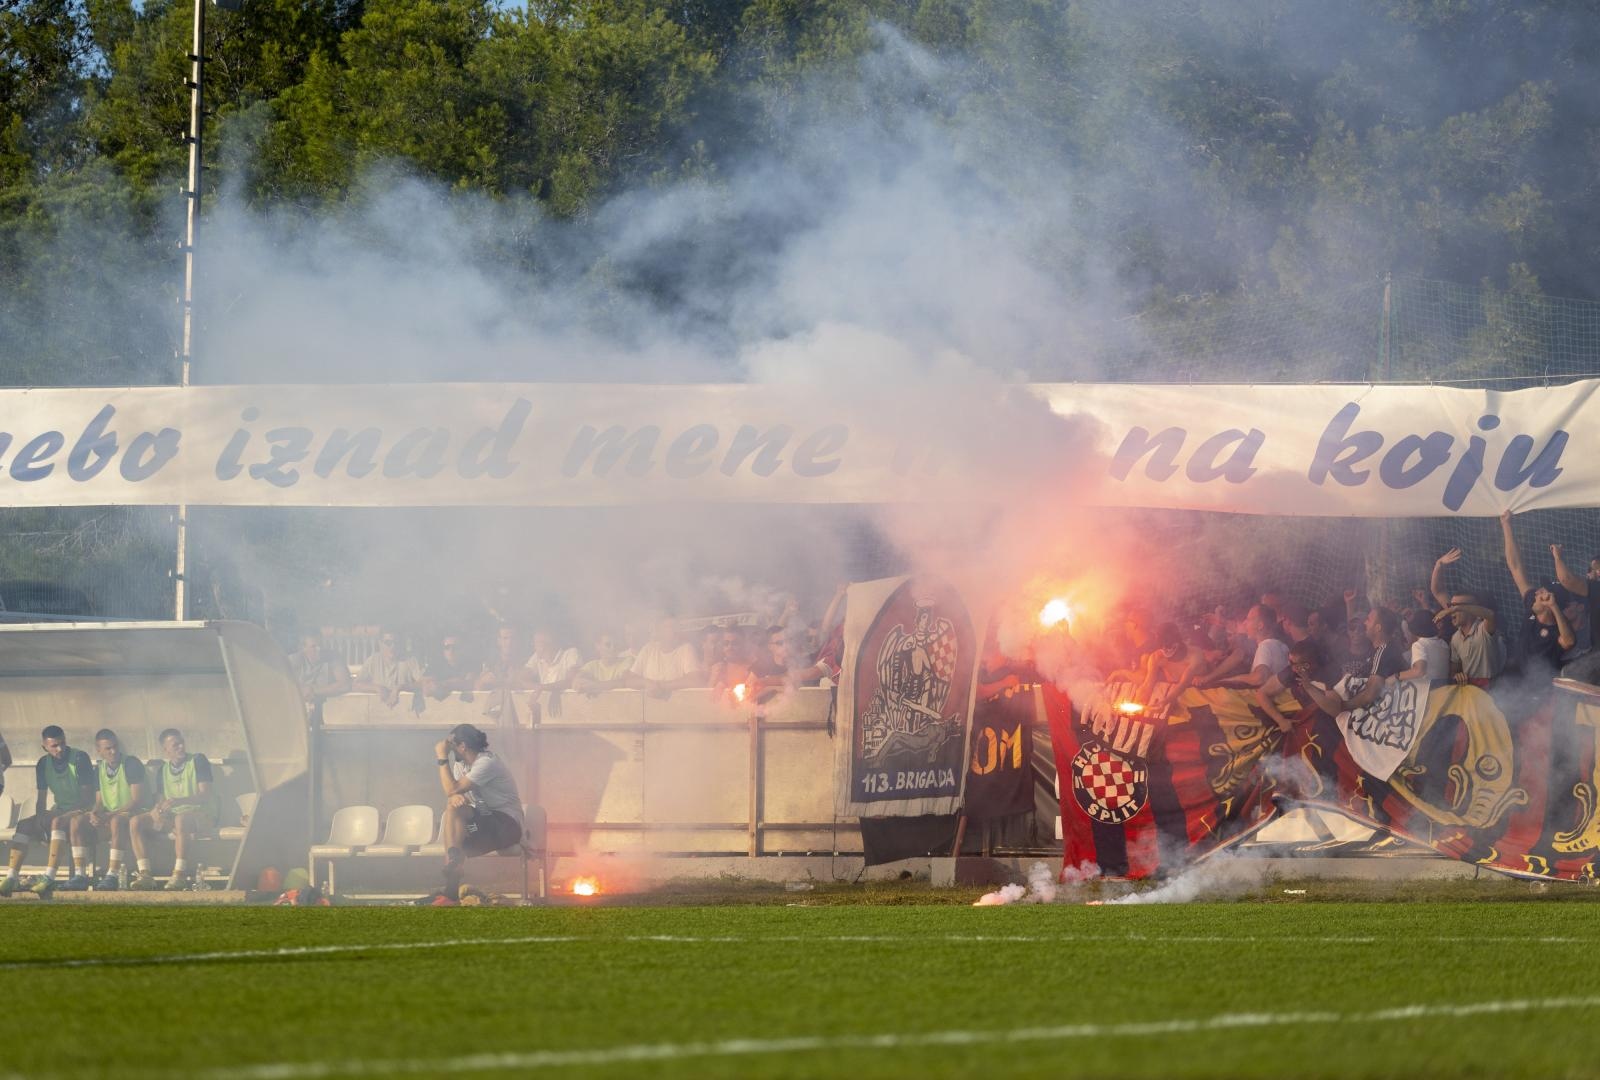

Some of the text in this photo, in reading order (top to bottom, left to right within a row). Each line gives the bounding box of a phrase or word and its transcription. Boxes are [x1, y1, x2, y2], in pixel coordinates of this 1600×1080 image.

[0, 403, 182, 482] ebo
[215, 399, 533, 488] iznad
[561, 421, 850, 479] mene
[1108, 425, 1266, 485] na
[1307, 401, 1570, 512] koju
[895, 768, 956, 790] BRIGADA
[1087, 800, 1139, 823] SPLIT
